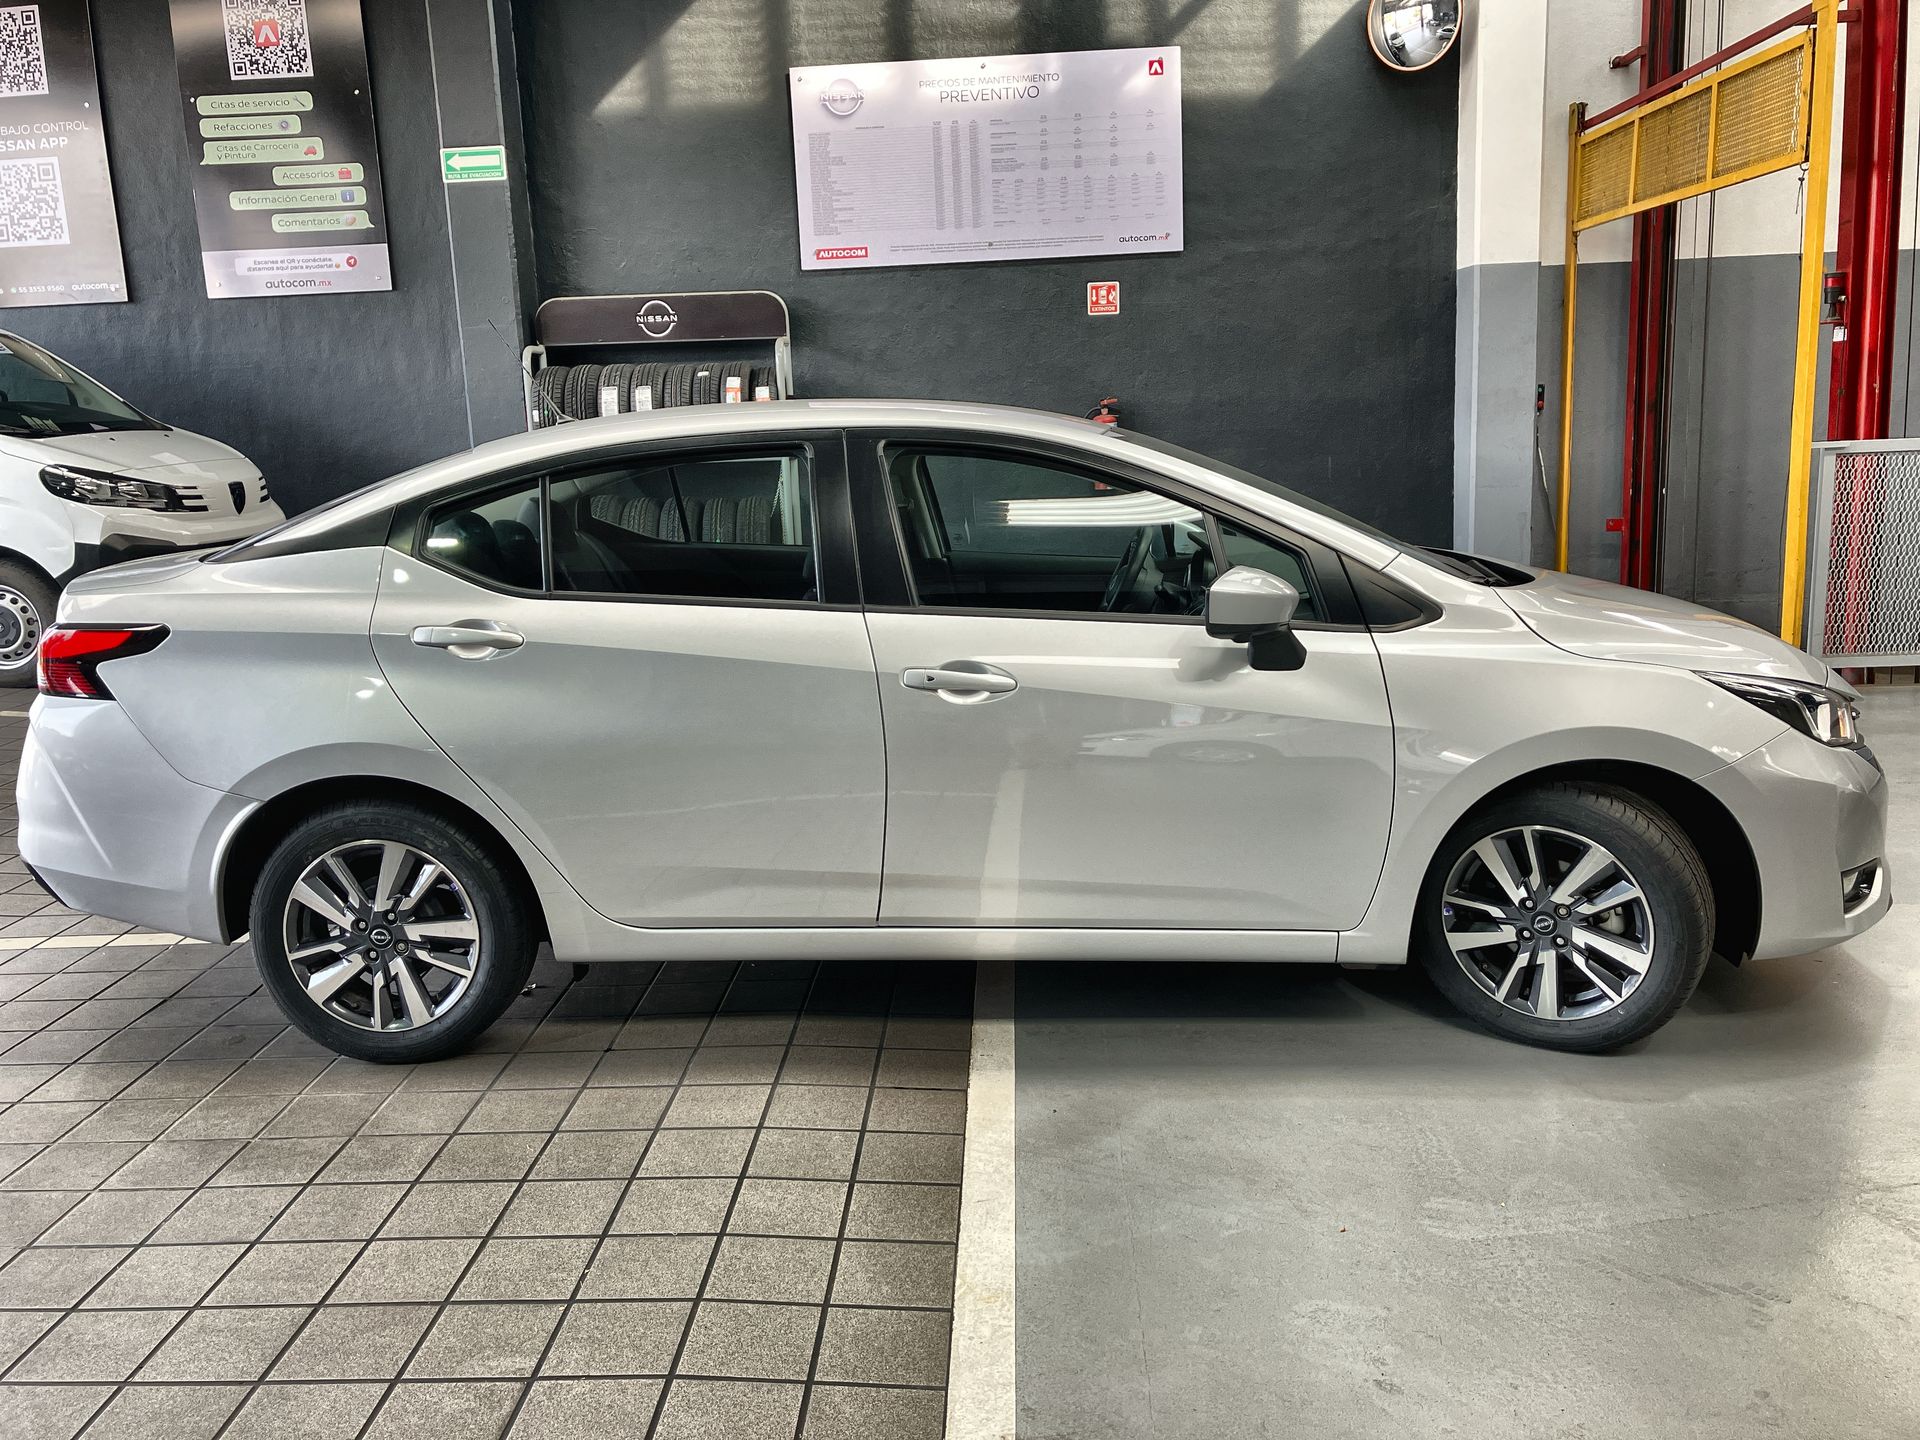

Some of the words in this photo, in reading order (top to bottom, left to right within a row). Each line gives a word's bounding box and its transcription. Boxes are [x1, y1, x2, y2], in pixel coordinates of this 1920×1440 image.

[918, 79, 960, 89] PRECIOS
[962, 77, 976, 86] DE
[977, 73, 1060, 86] MANTENIMIENTO
[819, 89, 865, 100] NISSAN
[939, 85, 1040, 103] PREVENTIVO
[210, 101, 236, 109] Citas
[237, 100, 251, 108] de
[252, 98, 290, 108] servicio
[0, 125, 31, 136] BAJO
[33, 120, 89, 134] CONTROL
[213, 122, 273, 132] Refacciones
[40, 136, 68, 150] APP
[216, 144, 239, 152] Citas
[240, 144, 252, 152] de
[224, 152, 257, 160] Pintura
[282, 170, 335, 180] Accesorios
[238, 194, 298, 206] Información
[299, 192, 337, 203] General
[277, 217, 341, 228] Comentarios
[1118, 235, 1169, 243] autocom.mx
[818, 249, 866, 259] AUTOCOM
[265, 278, 333, 290] autocom.mx
[635, 314, 678, 323] NISSAN
